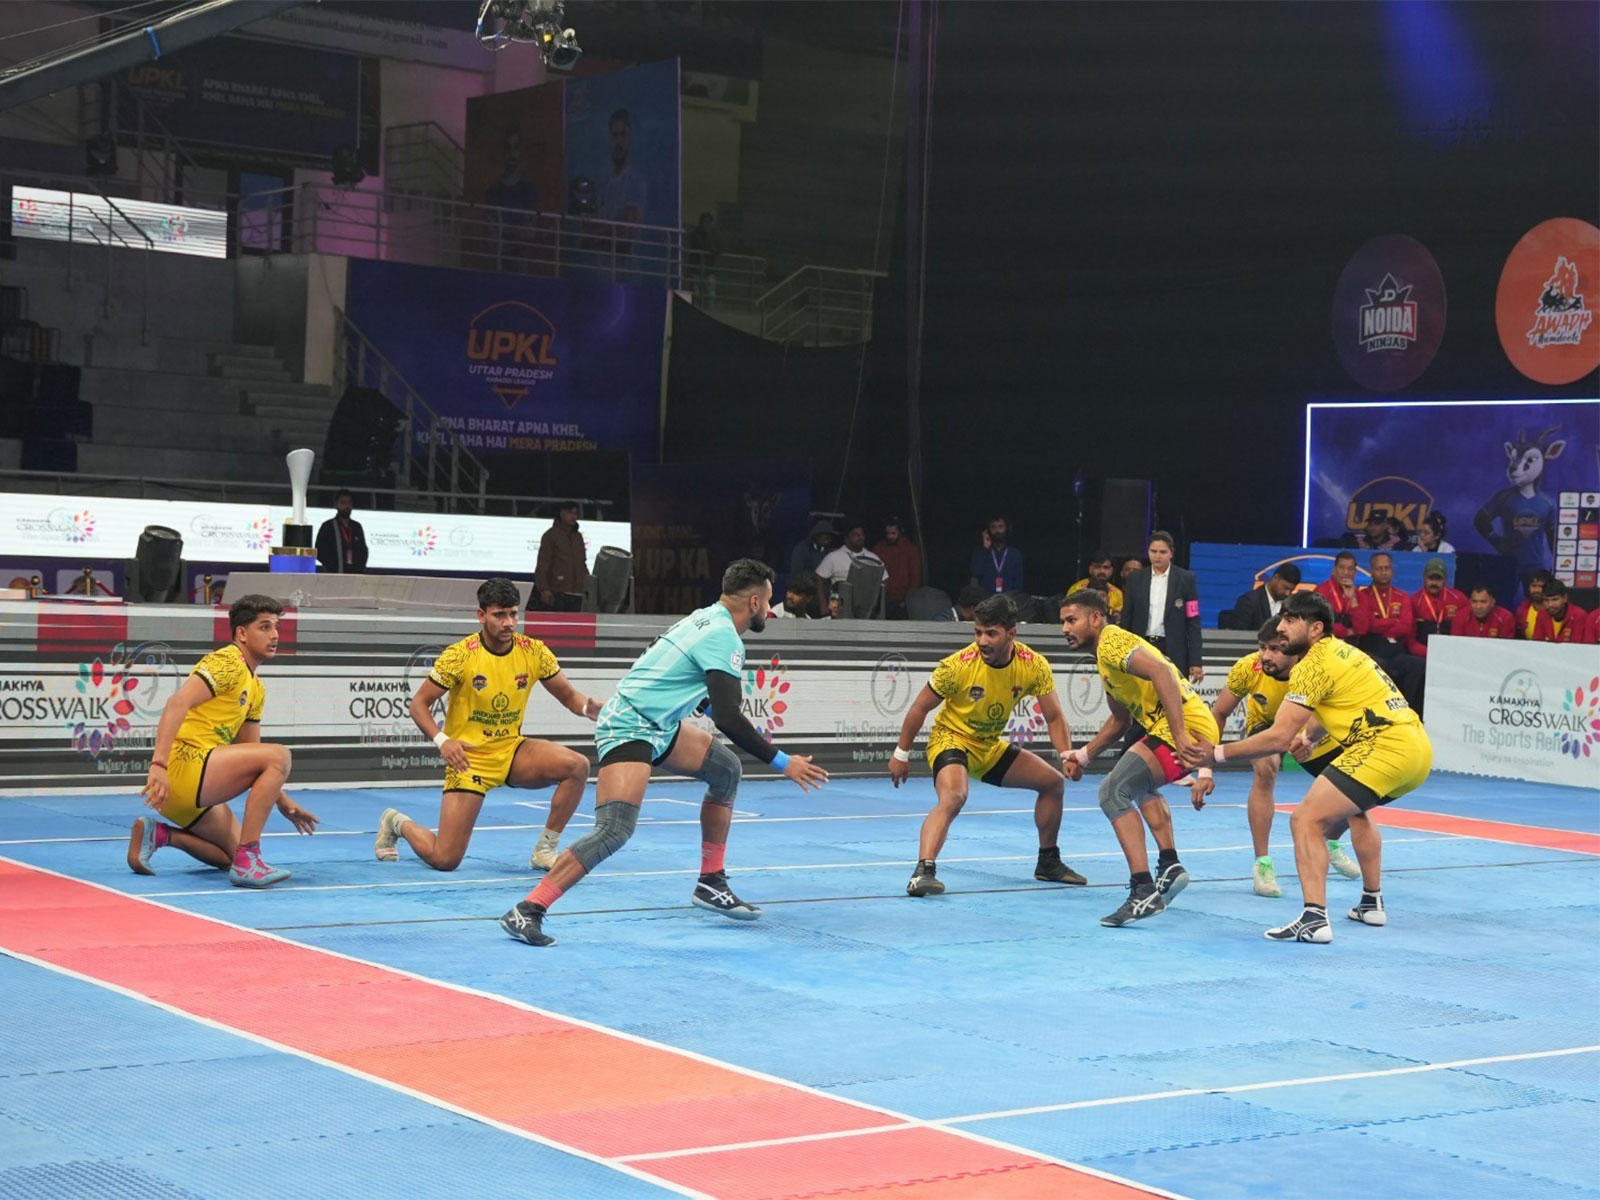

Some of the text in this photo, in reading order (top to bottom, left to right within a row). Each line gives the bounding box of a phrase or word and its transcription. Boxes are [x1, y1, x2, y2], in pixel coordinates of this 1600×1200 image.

[1364, 306, 1412, 336] NOIDA
[1528, 311, 1592, 335] AWADH
[466, 328, 557, 366] UPKL
[1368, 337, 1407, 350] NINJAS
[469, 364, 553, 380] UTTAR PRADESH
[437, 416, 585, 439] PNA BHARAT APNA KHEL,
[486, 435, 507, 448] HAI
[510, 436, 541, 449] MERA
[544, 439, 598, 451] PRADESH
[0, 680, 45, 692] AKHYA
[350, 681, 411, 693] KAMAKHYA
[0, 697, 110, 720] OSSWALK
[1489, 695, 1541, 708] KAMAKHYA
[1489, 708, 1588, 732] CROSSWALK
[358, 721, 388, 744] The
[834, 720, 857, 741] The
[1462, 723, 1485, 744] The
[1488, 726, 1531, 750] Sports
[382, 755, 408, 769] Injury
[410, 755, 420, 766] to
[853, 749, 875, 762] Injury
[875, 750, 884, 760] to
[97, 758, 128, 774] Injury
[130, 760, 142, 771] to
